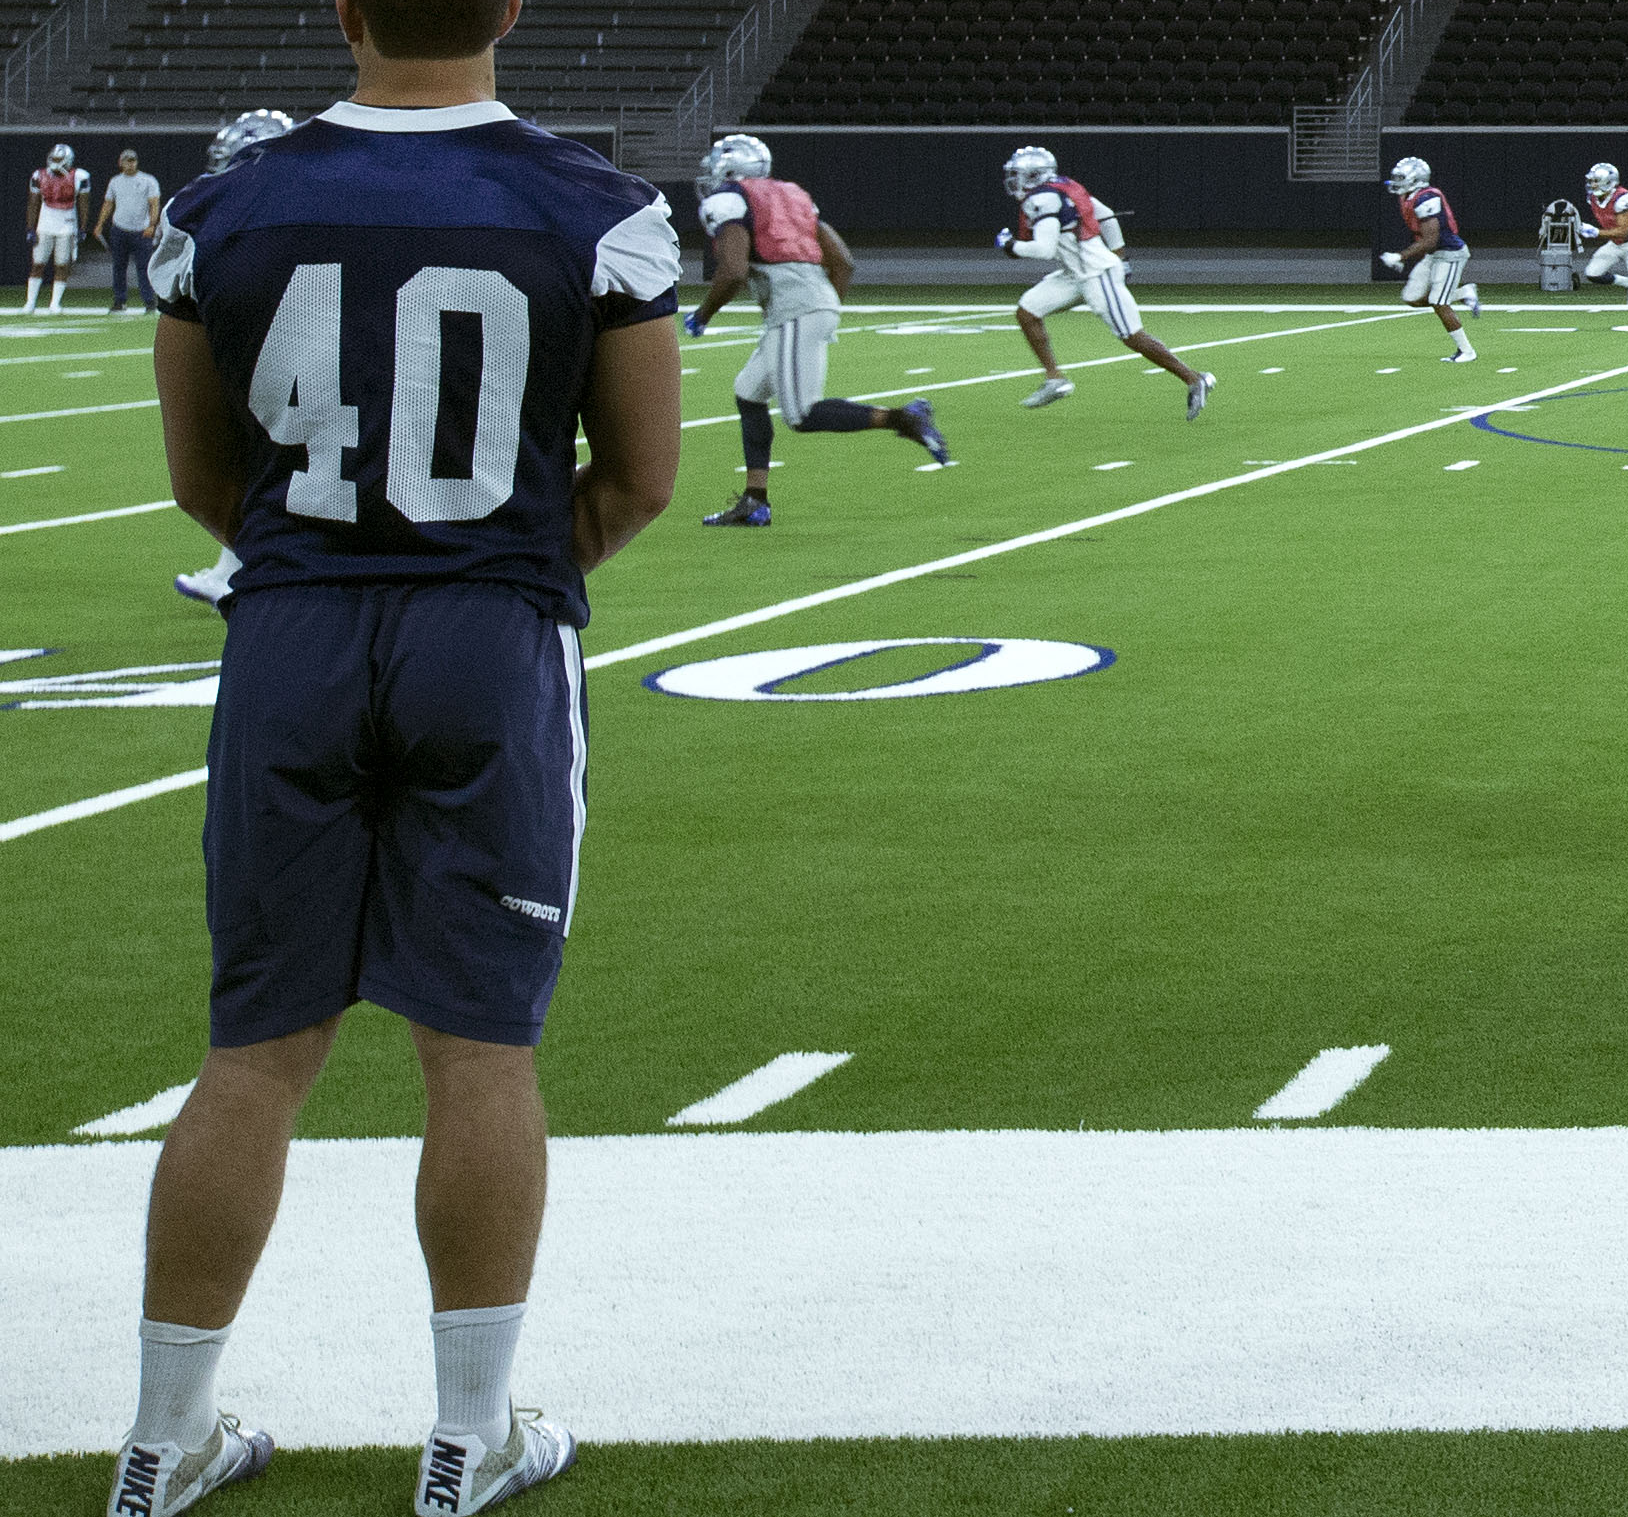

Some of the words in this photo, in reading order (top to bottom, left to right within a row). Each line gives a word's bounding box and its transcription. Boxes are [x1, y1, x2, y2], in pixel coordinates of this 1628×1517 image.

[249, 263, 530, 523] 40
[642, 636, 1116, 701] 0
[500, 895, 561, 923] COWBOYS
[116, 1445, 162, 1517] NIKE
[424, 1438, 468, 1514] NIKE
